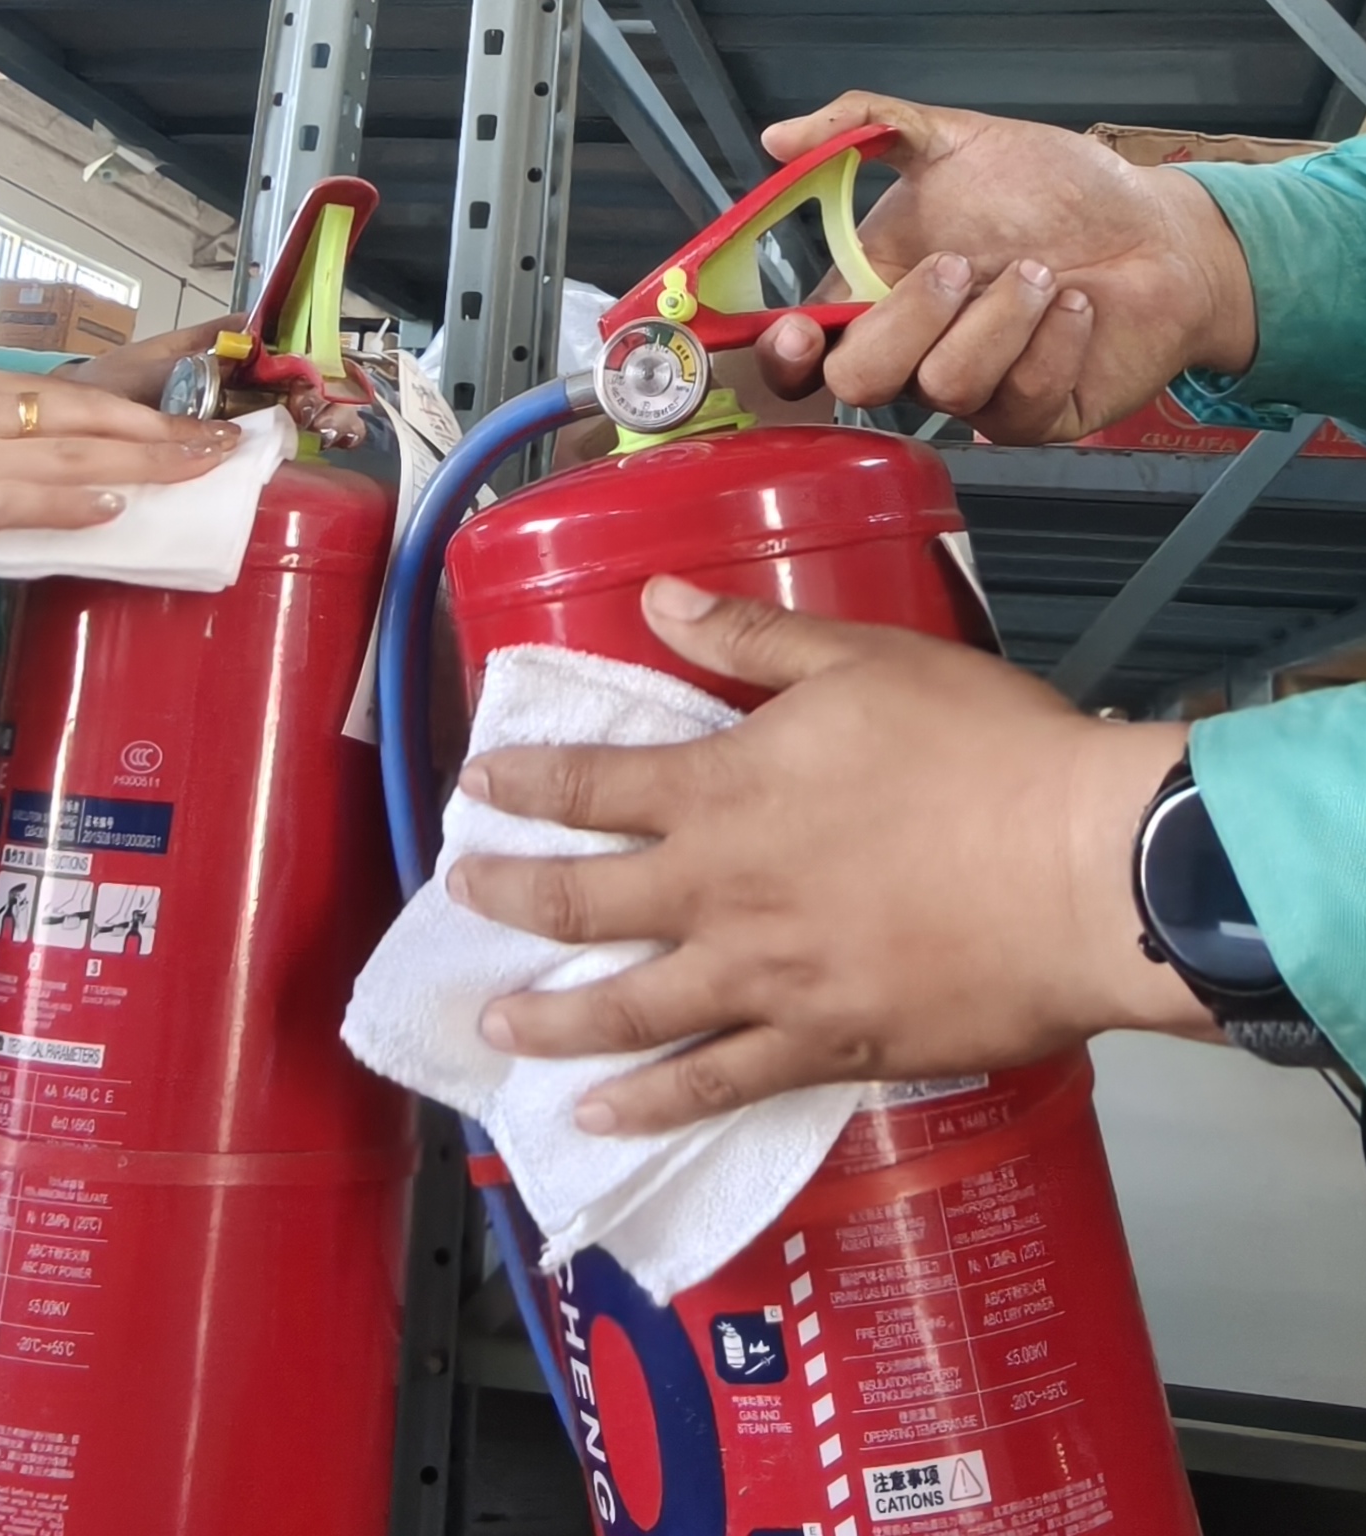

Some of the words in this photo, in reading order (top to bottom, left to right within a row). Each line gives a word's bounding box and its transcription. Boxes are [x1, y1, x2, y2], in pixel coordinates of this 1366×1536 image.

[738, 1409, 759, 1421] GAS
[760, 1409, 781, 1421] AND
[737, 1422, 769, 1435] STEAM
[872, 1465, 942, 1494] 注意事项
[875, 1490, 945, 1515] CATIONS
